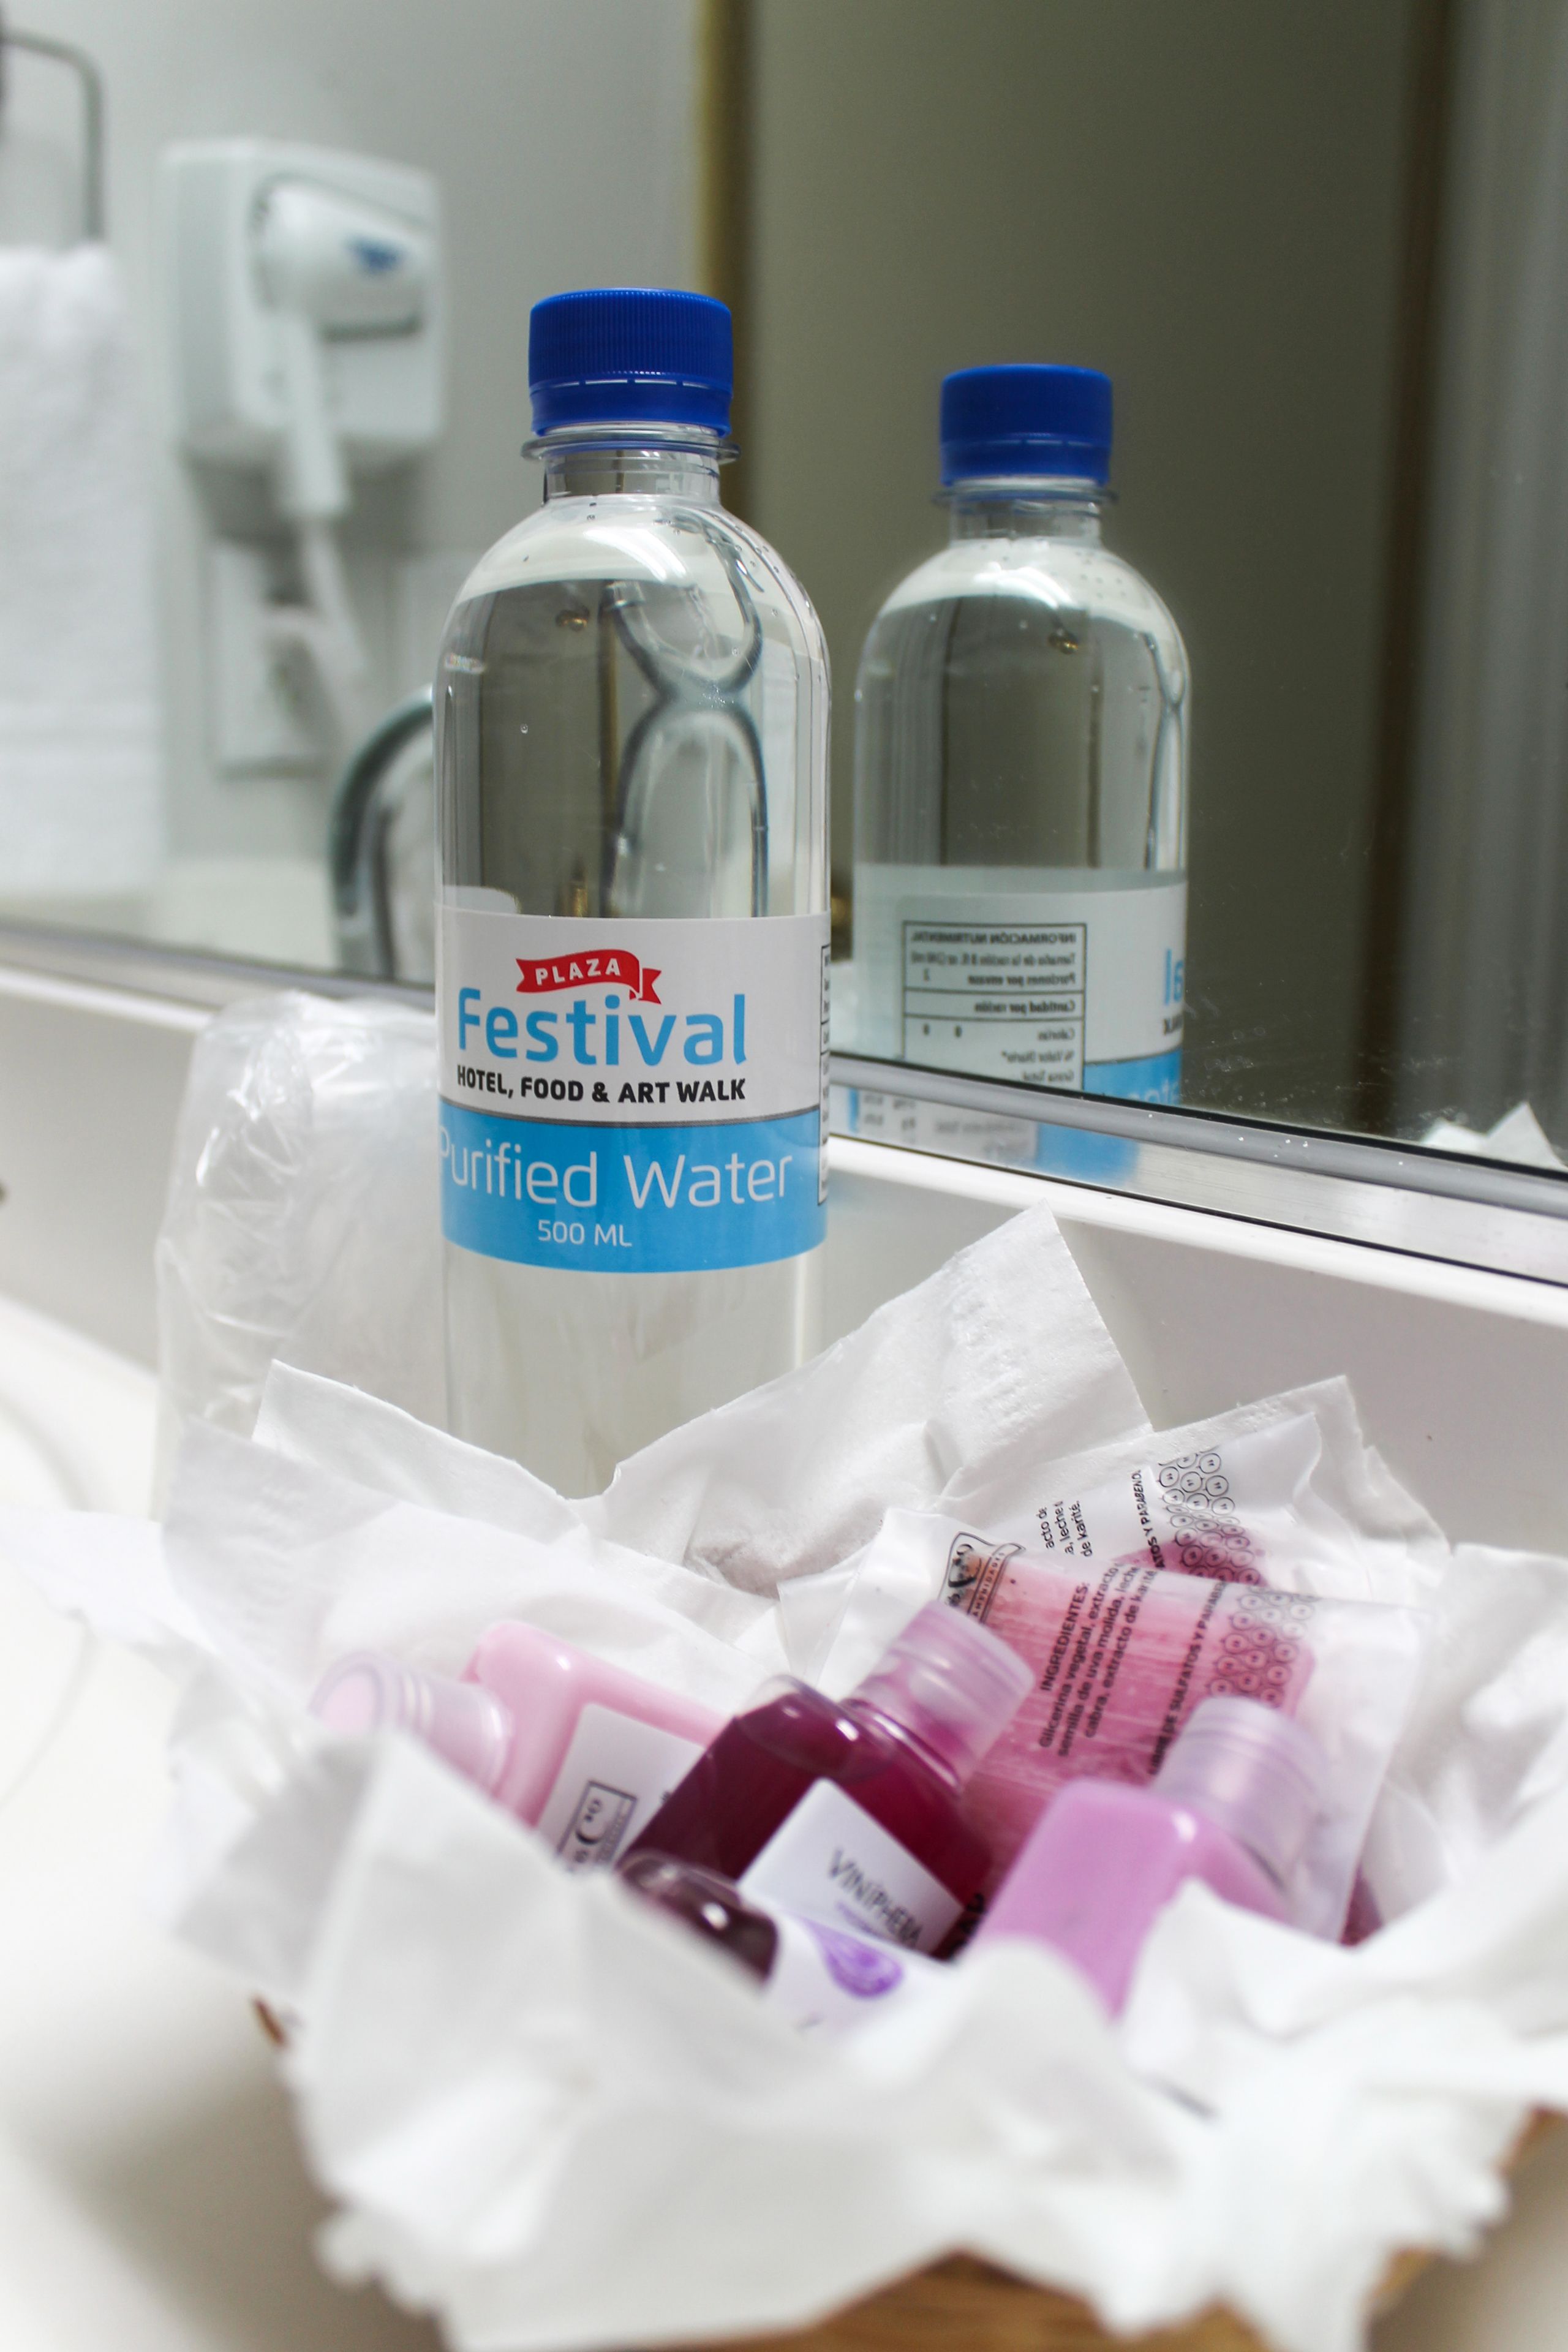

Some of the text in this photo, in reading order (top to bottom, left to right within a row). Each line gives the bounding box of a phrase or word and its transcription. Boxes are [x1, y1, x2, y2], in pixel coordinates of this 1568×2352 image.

[535, 957, 622, 986] PLAZA
[458, 987, 747, 1066] Festival
[457, 1065, 746, 1103] HOTEL, FOOD & ART WALK
[439, 1125, 793, 1208] Purified Water
[537, 1219, 632, 1247] 500 ML
[1054, 1507, 1071, 1542] leche
[1142, 1526, 1153, 1537] Y
[1080, 1540, 1093, 1557] de
[1124, 1604, 1140, 1624] de
